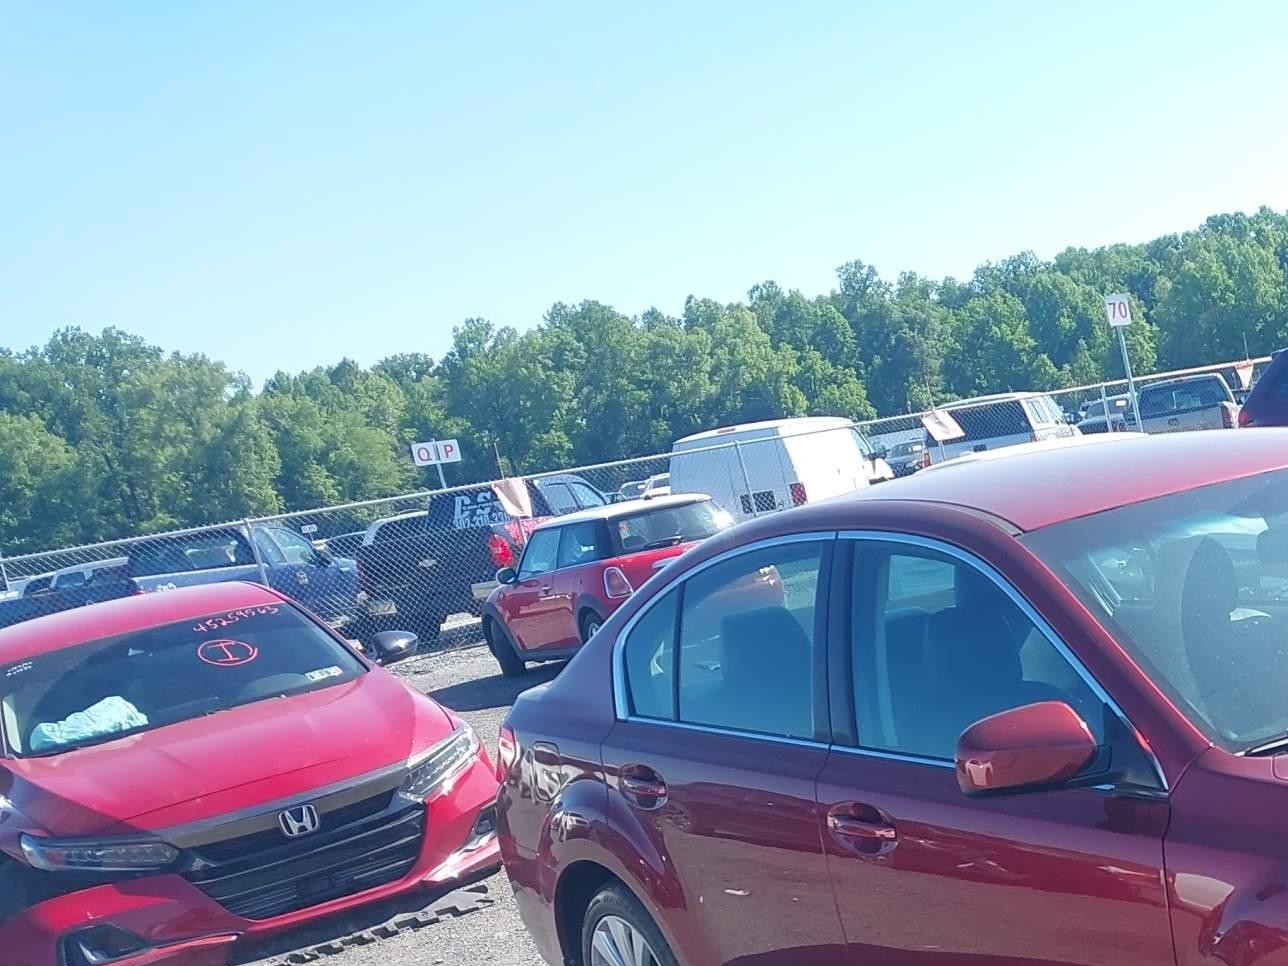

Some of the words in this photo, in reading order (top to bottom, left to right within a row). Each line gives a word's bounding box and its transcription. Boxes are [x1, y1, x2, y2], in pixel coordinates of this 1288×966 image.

[1107, 301, 1128, 319] 70
[416, 447, 432, 462] Q
[443, 444, 454, 459] P
[192, 605, 279, 633] 45259563
